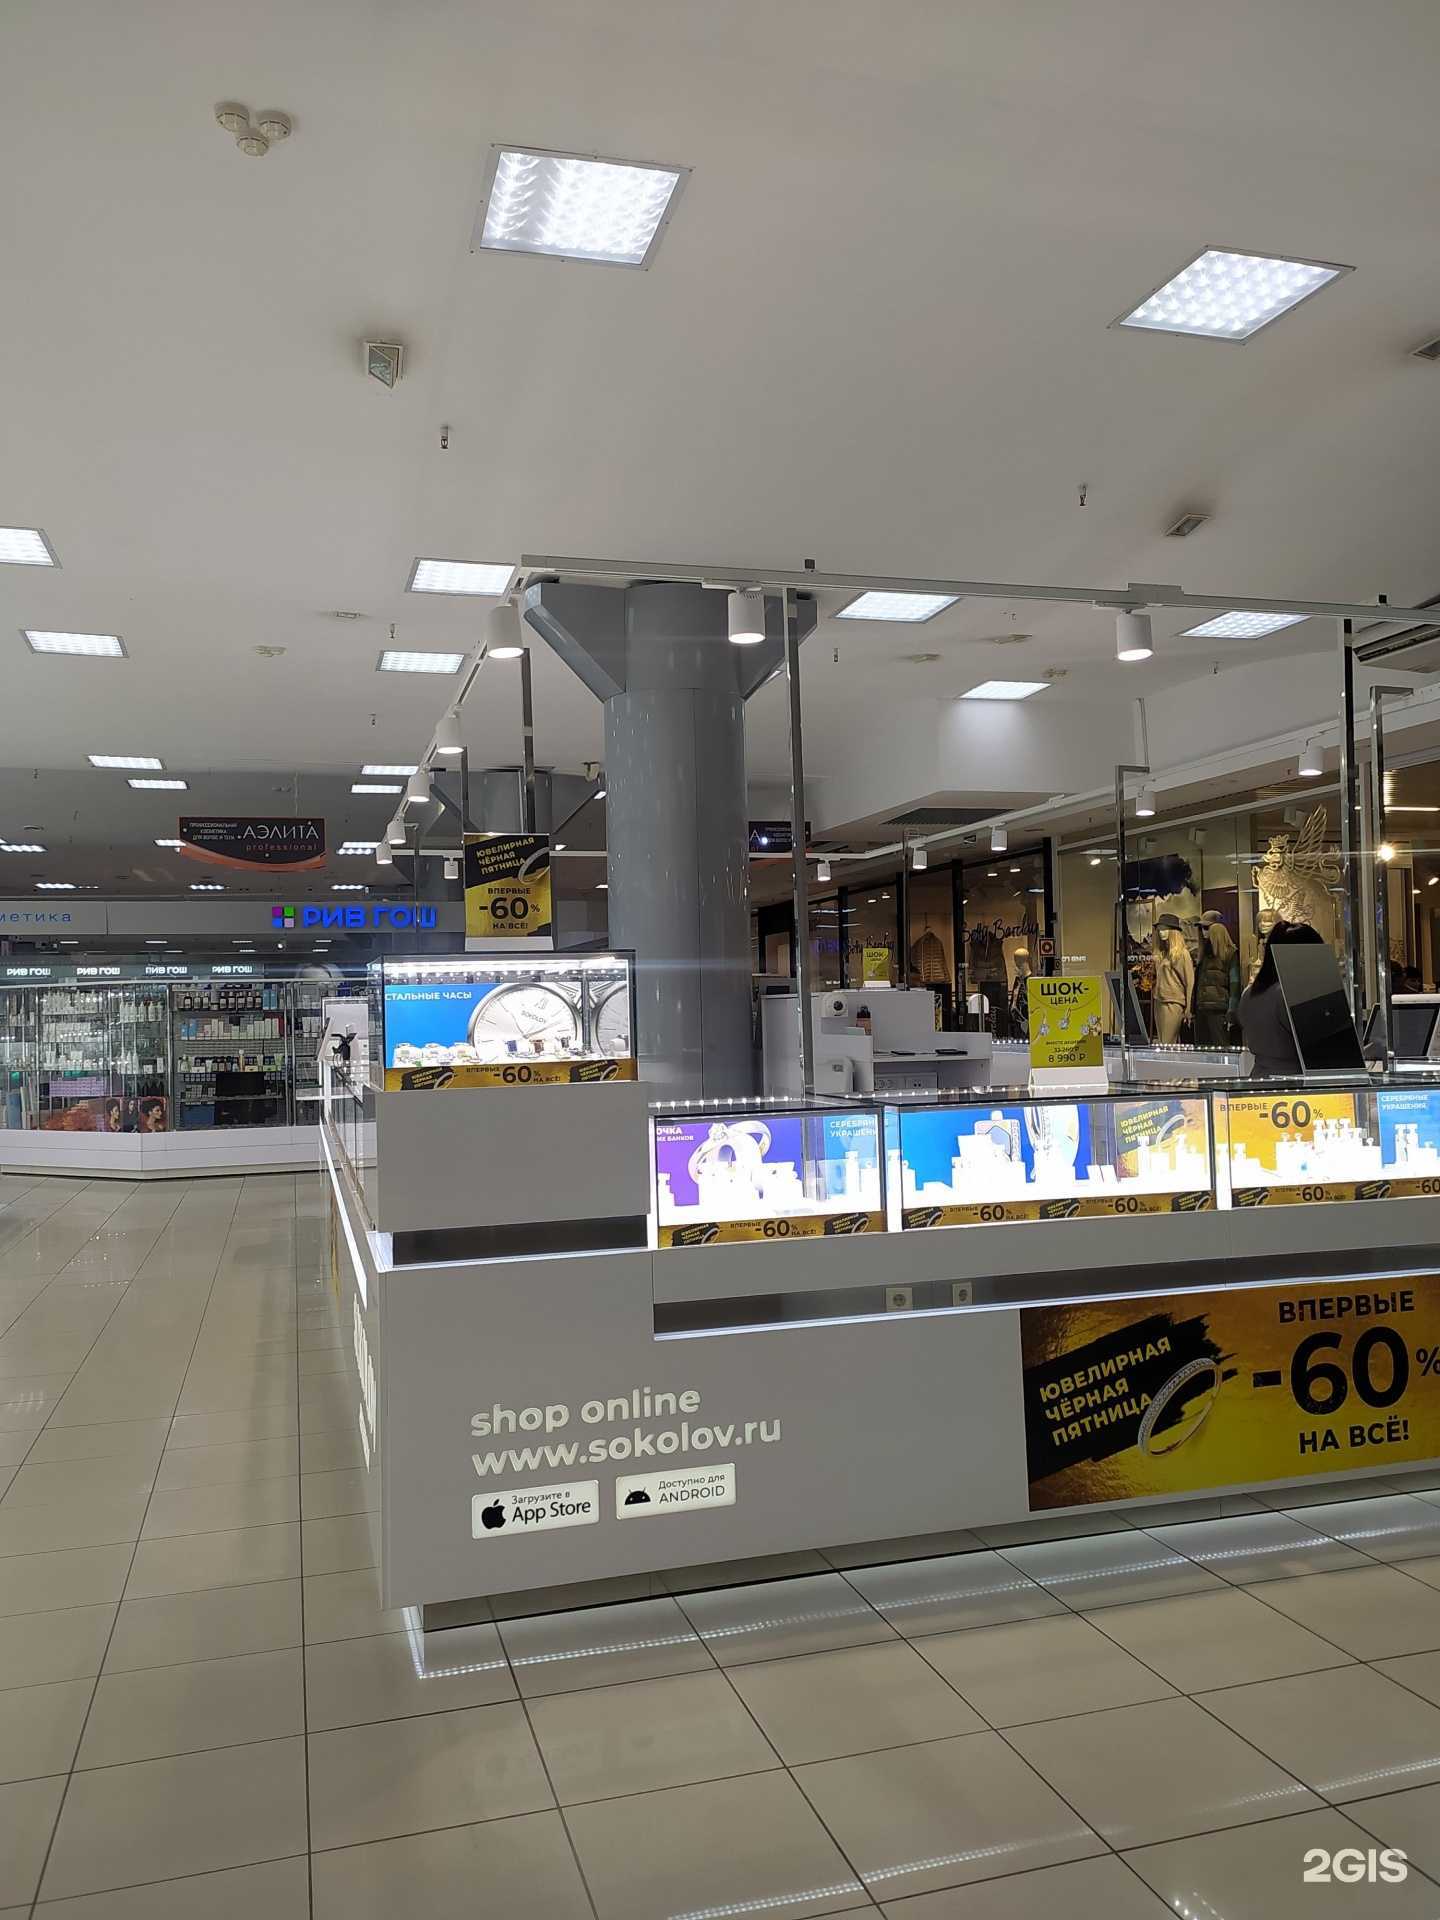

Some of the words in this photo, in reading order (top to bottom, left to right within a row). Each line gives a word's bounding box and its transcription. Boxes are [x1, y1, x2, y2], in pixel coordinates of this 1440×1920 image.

[242, 825, 319, 839] АЭЛИТА
[246, 842, 316, 852] professional
[476, 837, 535, 858] ЮВЕЛИРНАЯ
[481, 857, 527, 875] ПЯТНИЦА
[487, 887, 532, 895] ВПЕРВЫЕ
[303, 905, 367, 928] РИВ
[373, 905, 437, 928] ГОШ
[492, 922, 506, 930] НА
[29, 967, 51, 976] ГОШ
[76, 967, 97, 976] РИВ
[99, 967, 121, 975] ГОШ
[166, 966, 188, 975] ГОШ
[233, 966, 253, 974] ГОШ
[384, 991, 441, 1001] СТАЛЬНЫЕ
[442, 991, 472, 1000] ЧАСЫ
[1040, 981, 1089, 996] ШОК-
[1050, 996, 1078, 1006] ЦЕНА
[1220, 1103, 1268, 1112] ВПЕРВЫЕ
[1120, 1105, 1169, 1127] ЮВЕЛИРНАЯ
[1278, 1290, 1415, 1323] ВПЕРВЫЕ
[1039, 1336, 1173, 1403] ЮВЕЛИРНАЯ
[1045, 1378, 1129, 1422] ЧЁРНАЯ
[470, 1403, 570, 1437] shop
[580, 1386, 701, 1424] online
[1052, 1392, 1153, 1448] ПЯТНИЦА
[1299, 1428, 1340, 1456] НА
[1349, 1416, 1410, 1449] ВСЁ!
[471, 1418, 782, 1477] www.sokolov.ru
[658, 1476, 706, 1490] Доступно
[707, 1474, 725, 1484] для
[511, 1491, 562, 1505] Загрузите
[659, 1485, 725, 1504] ANDROID
[512, 1507, 546, 1525] App
[550, 1502, 591, 1518] Store
